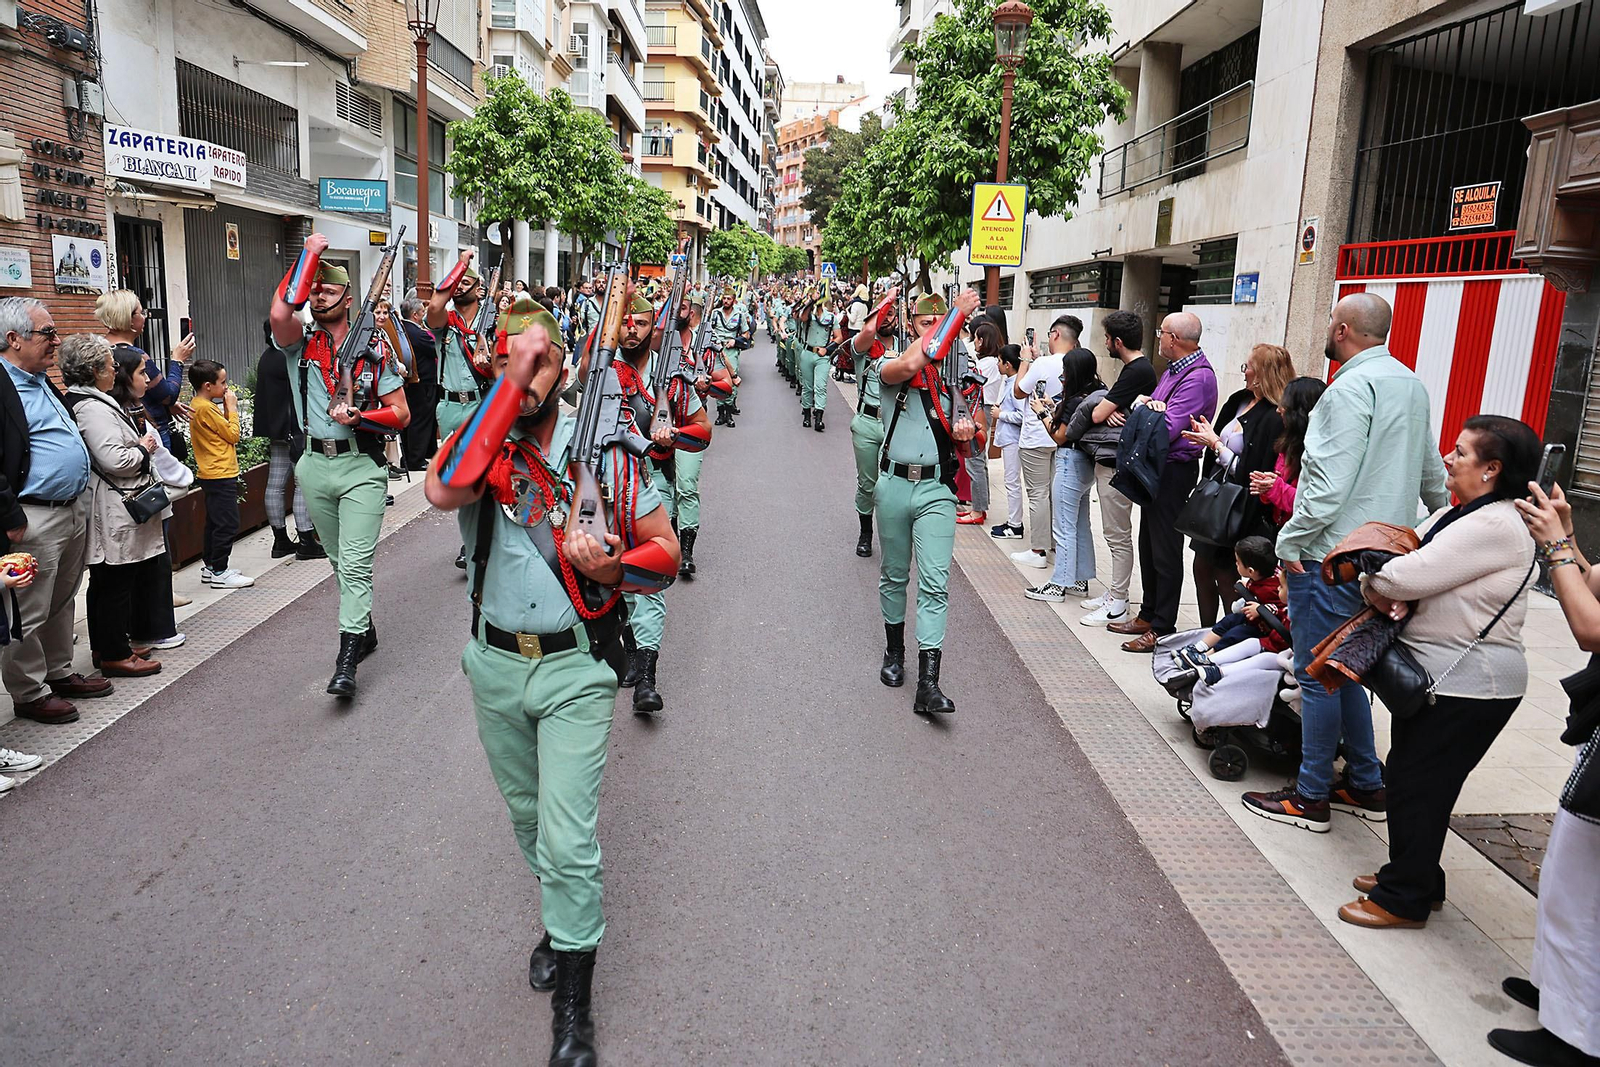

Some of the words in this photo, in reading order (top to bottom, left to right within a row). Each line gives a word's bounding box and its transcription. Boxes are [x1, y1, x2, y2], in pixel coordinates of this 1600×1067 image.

[108, 128, 206, 160] ZAPATERIA
[208, 145, 245, 167] ZAPATERO
[122, 155, 184, 179] BLANCA
[184, 165, 197, 182] II
[213, 166, 242, 183] RAPIDO
[326, 180, 381, 207] Bocanegra
[1455, 190, 1464, 203] SE
[1465, 185, 1496, 202] ALQUILA
